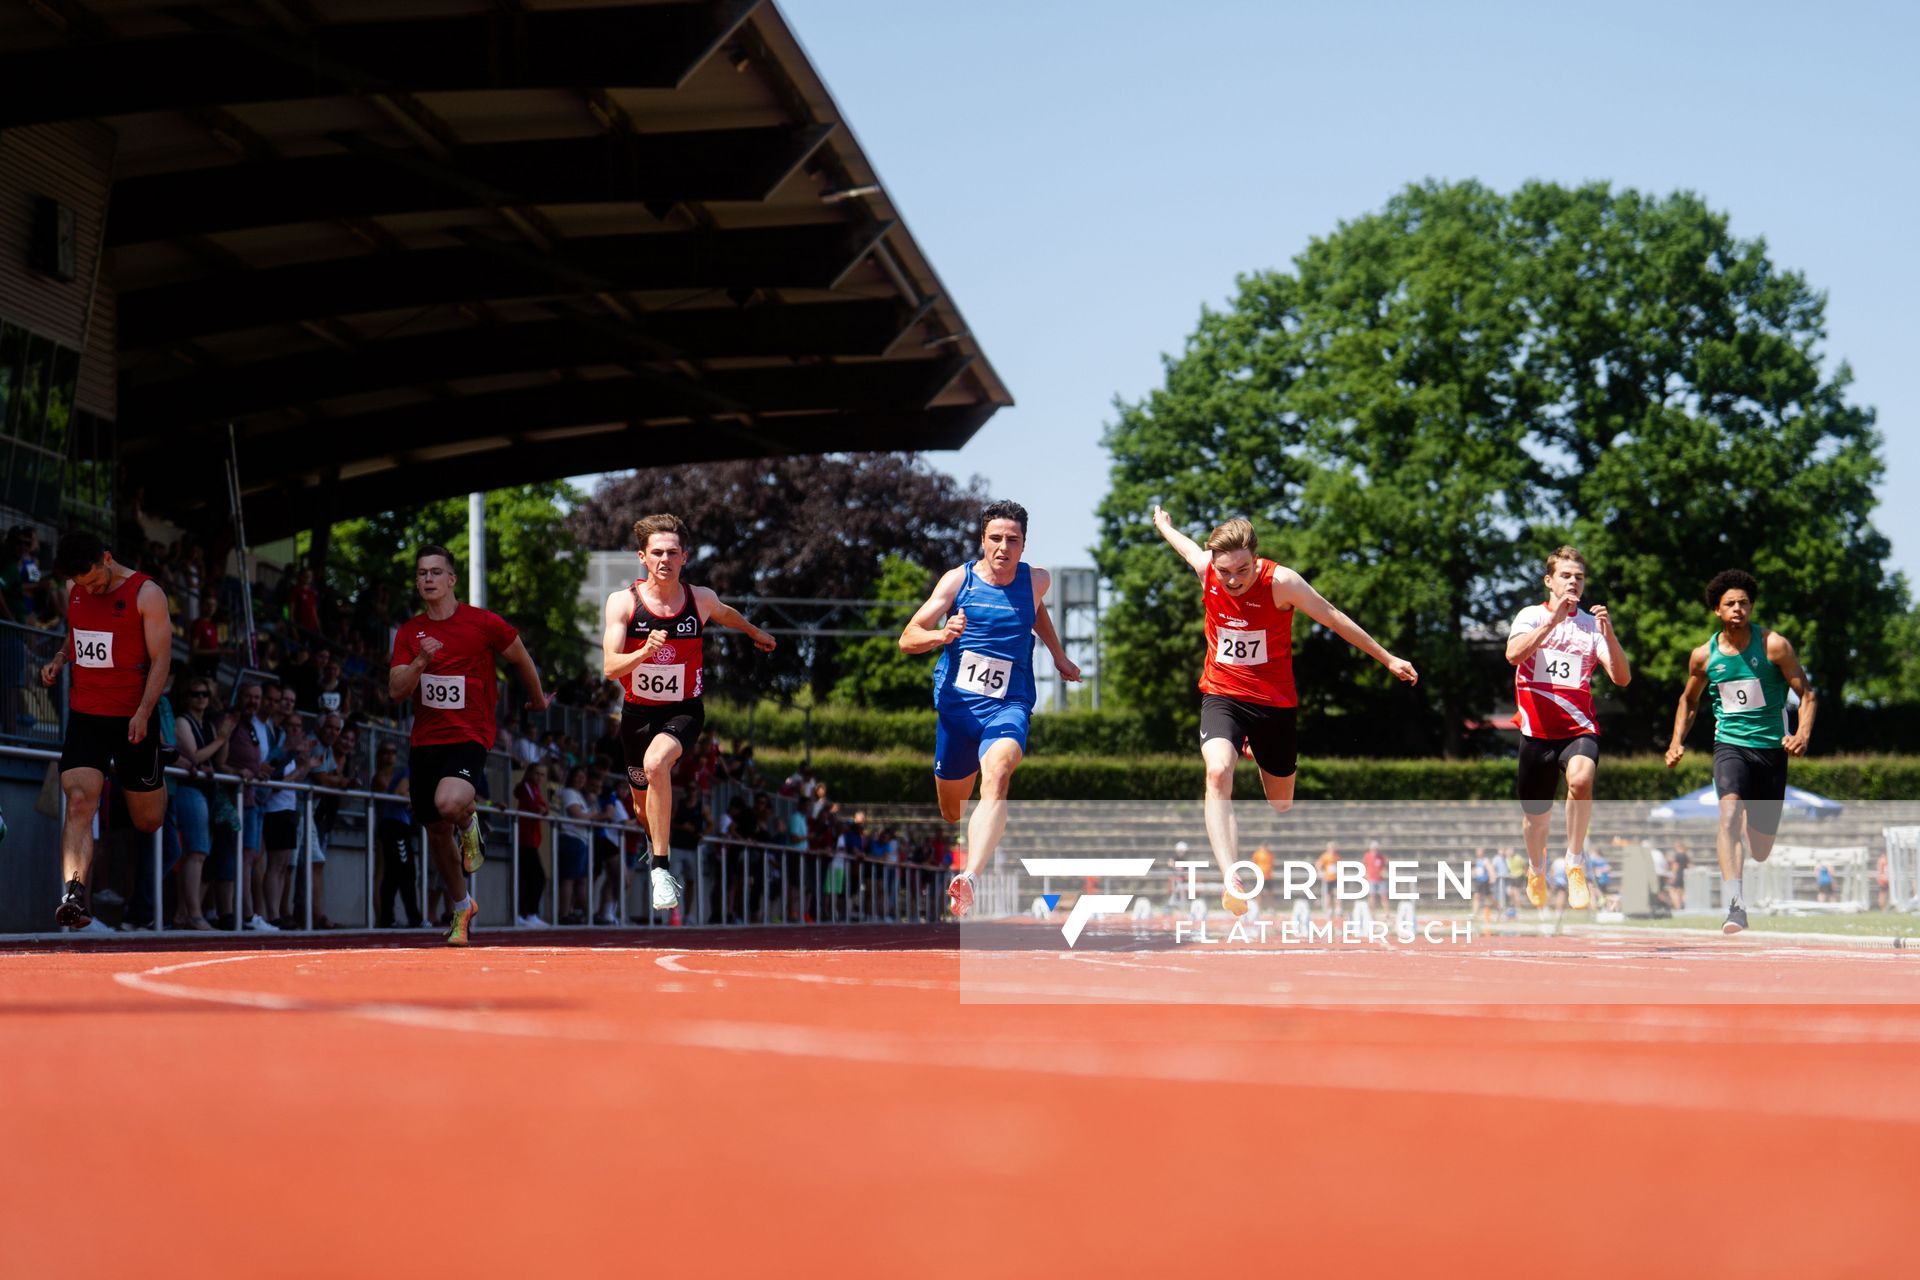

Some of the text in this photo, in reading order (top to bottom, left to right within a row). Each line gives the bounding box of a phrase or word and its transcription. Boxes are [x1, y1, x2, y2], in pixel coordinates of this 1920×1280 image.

[676, 622, 693, 633] OS
[76, 640, 107, 661] 346
[1223, 638, 1261, 659] 287
[967, 663, 1005, 690] 145
[1545, 660, 1571, 679] 43
[426, 683, 461, 703] 393
[638, 673, 679, 694] 364
[1736, 689, 1748, 705] 9
